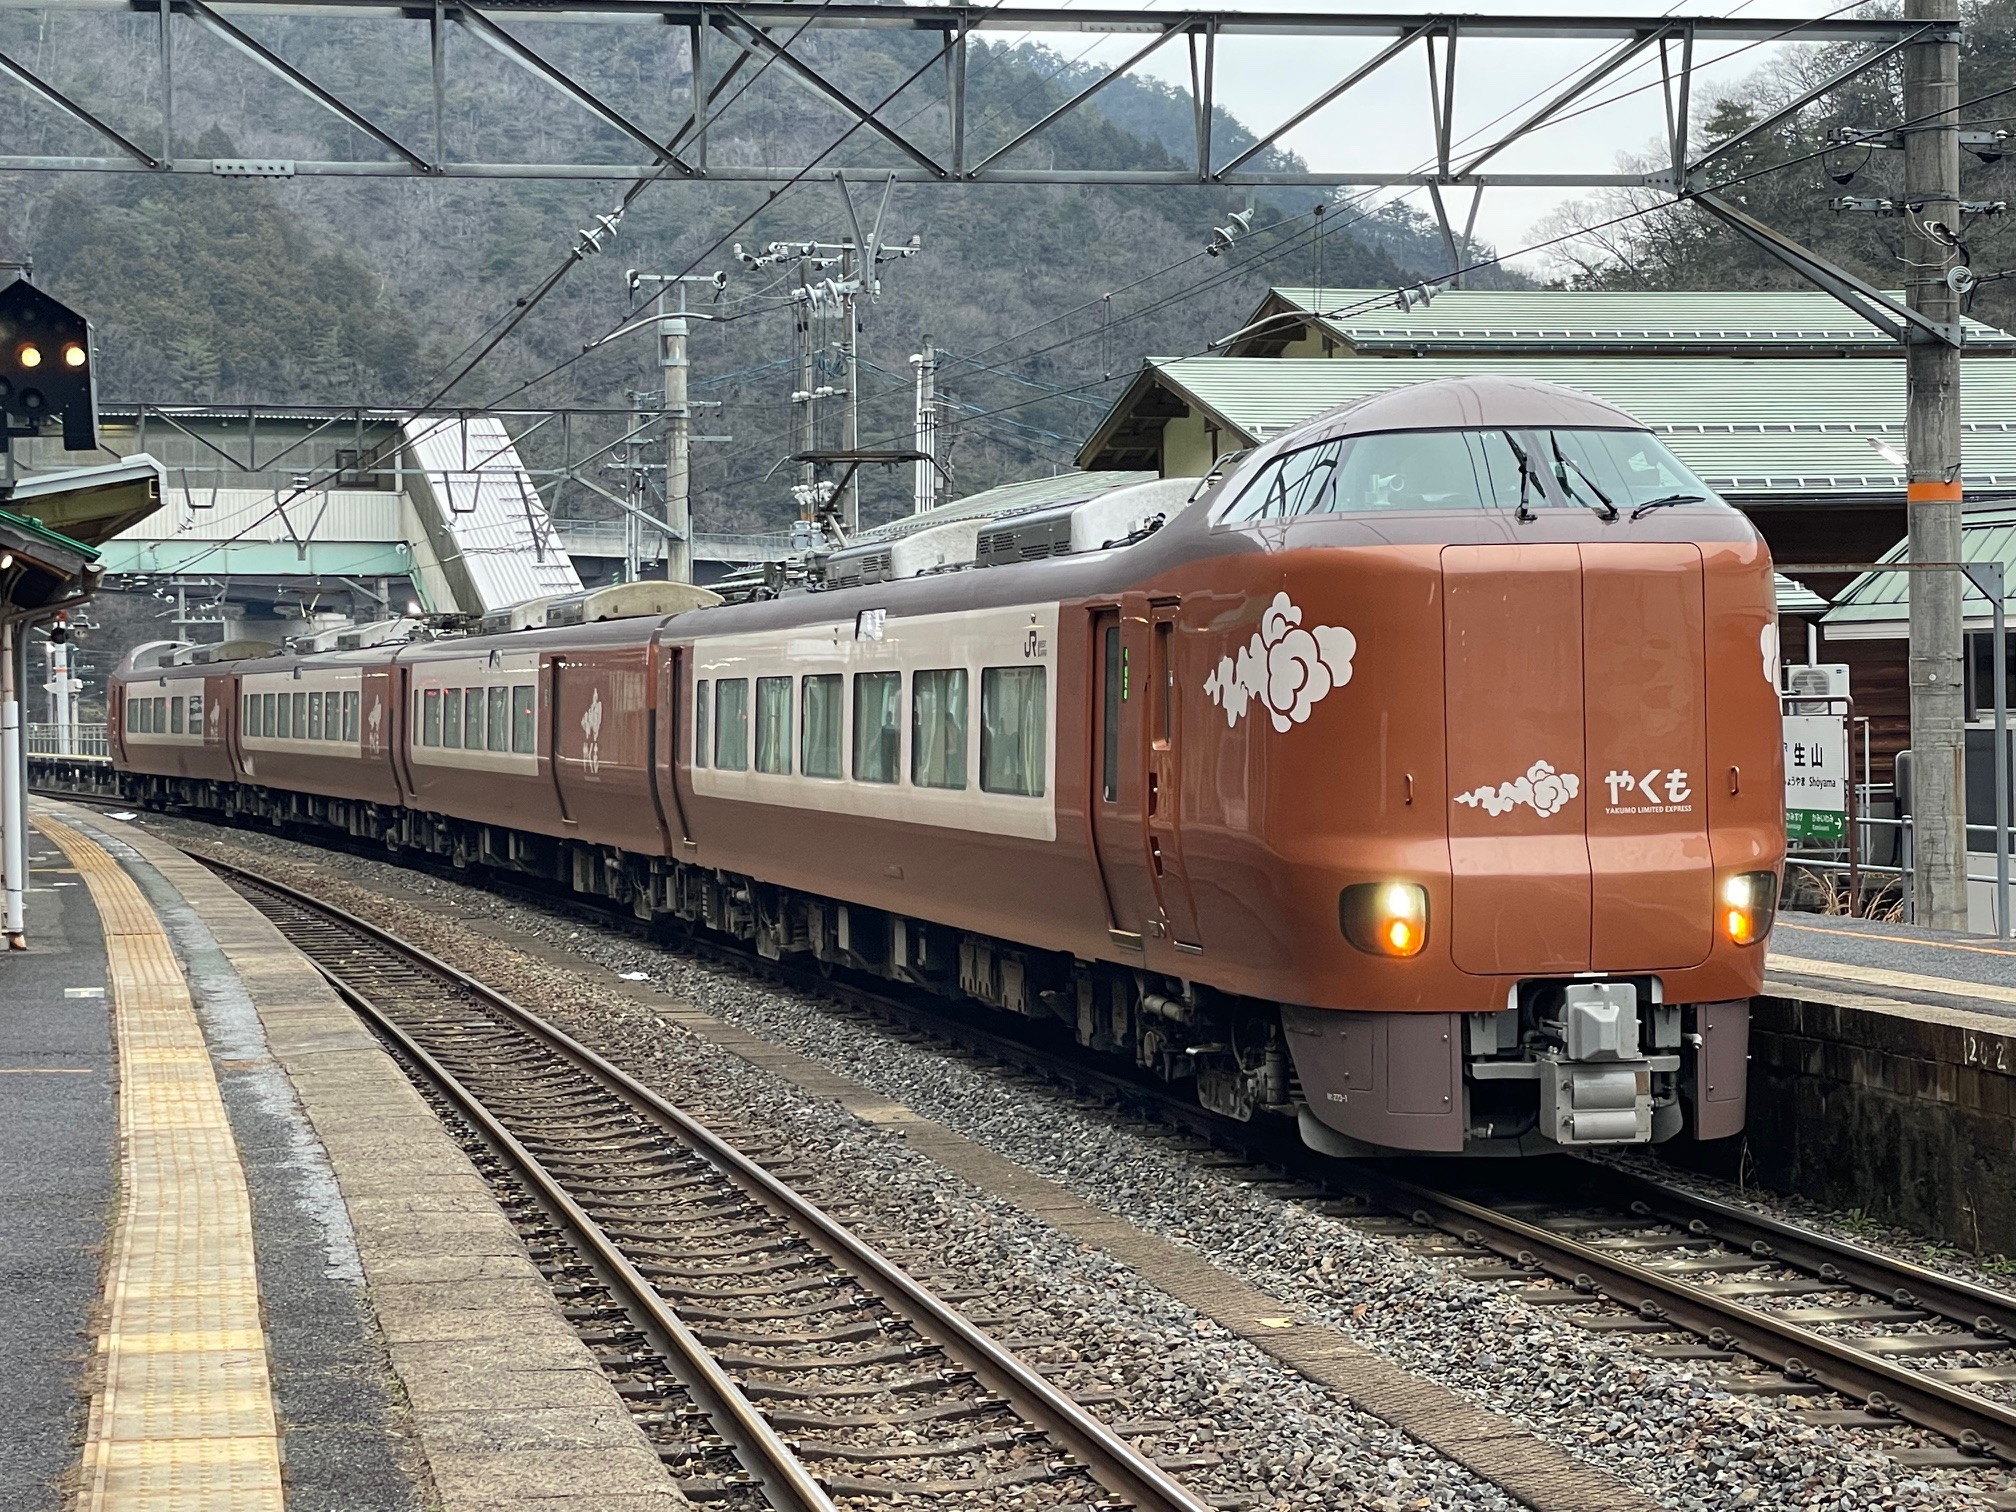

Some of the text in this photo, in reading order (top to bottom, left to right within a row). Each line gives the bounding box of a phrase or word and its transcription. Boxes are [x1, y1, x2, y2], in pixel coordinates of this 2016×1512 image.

[1024, 630, 1037, 658] JR
[1794, 743, 1823, 768] 生山
[1604, 768, 1692, 805] やくも
[1605, 805, 1692, 814] YAKUMO LIMITED EXPRESS
